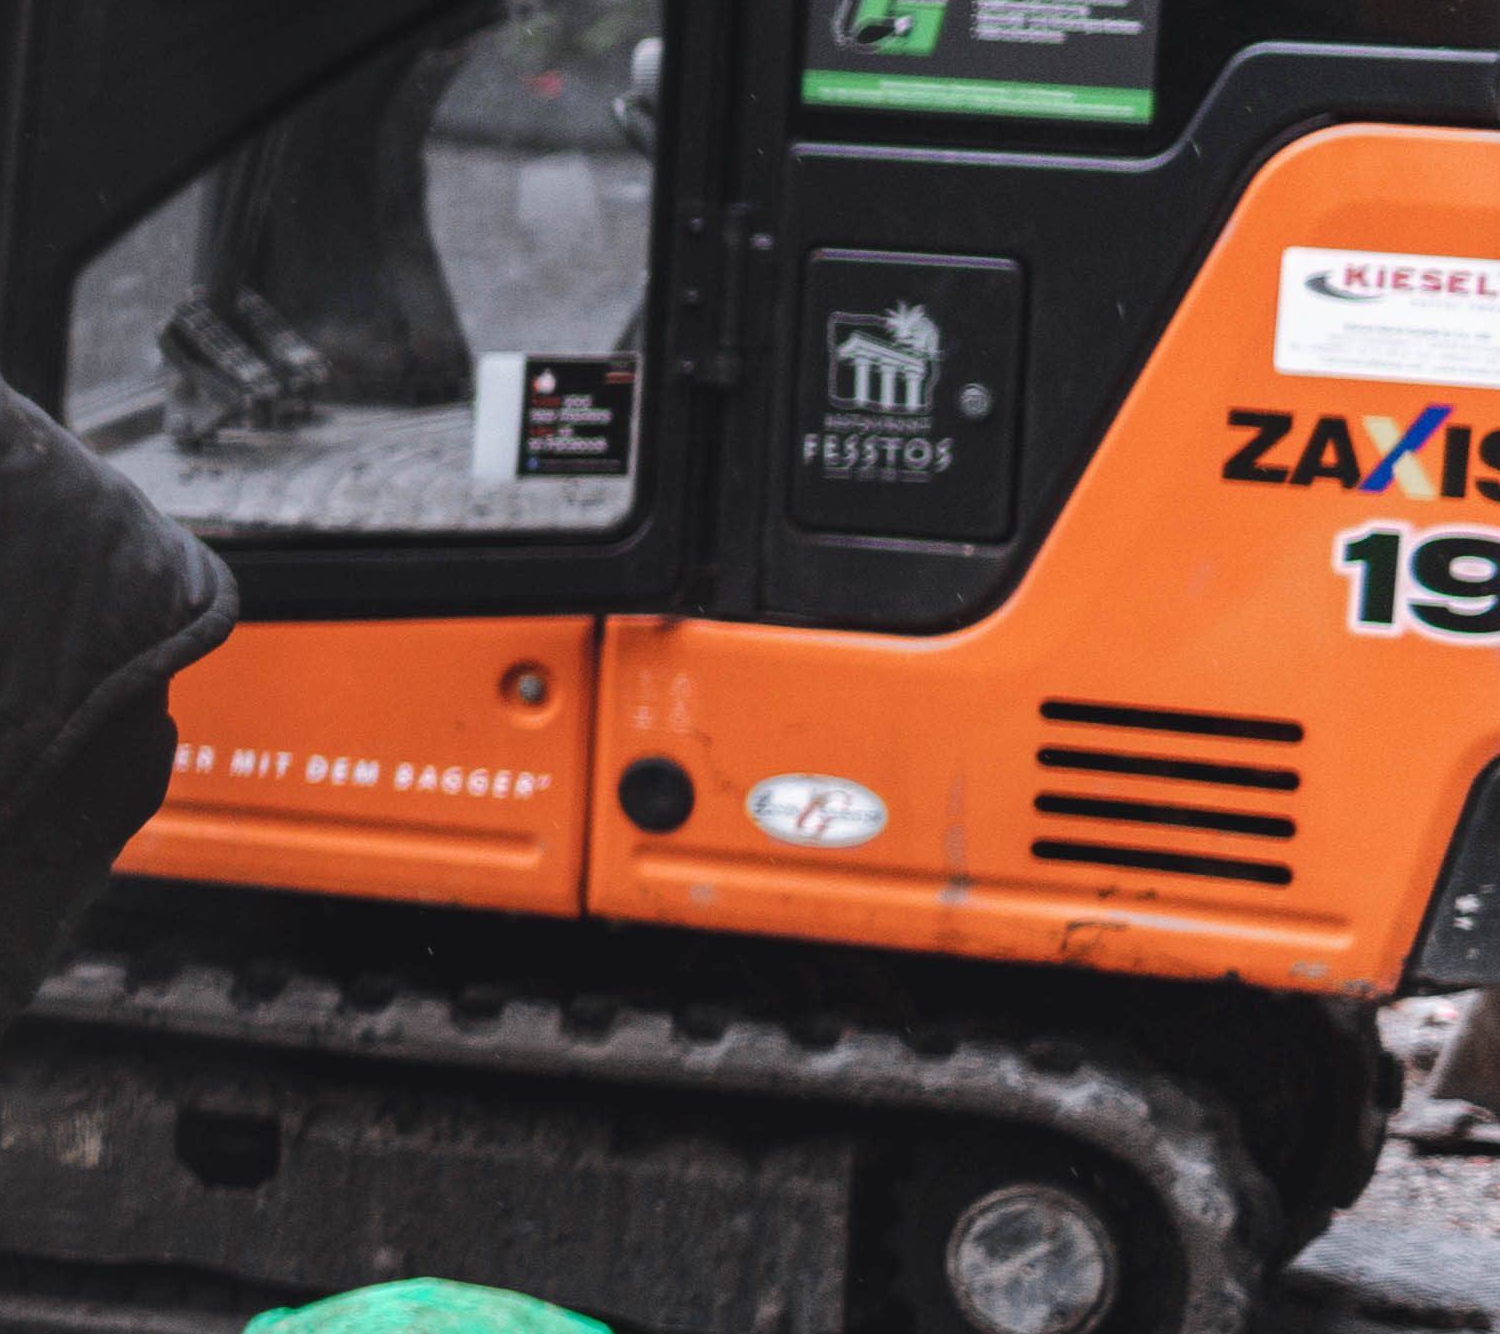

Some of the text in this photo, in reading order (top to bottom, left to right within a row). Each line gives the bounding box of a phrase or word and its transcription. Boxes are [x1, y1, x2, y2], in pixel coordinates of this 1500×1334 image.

[1342, 263, 1498, 297] KIESEL
[230, 748, 292, 779] MIT
[305, 754, 380, 785] DEM
